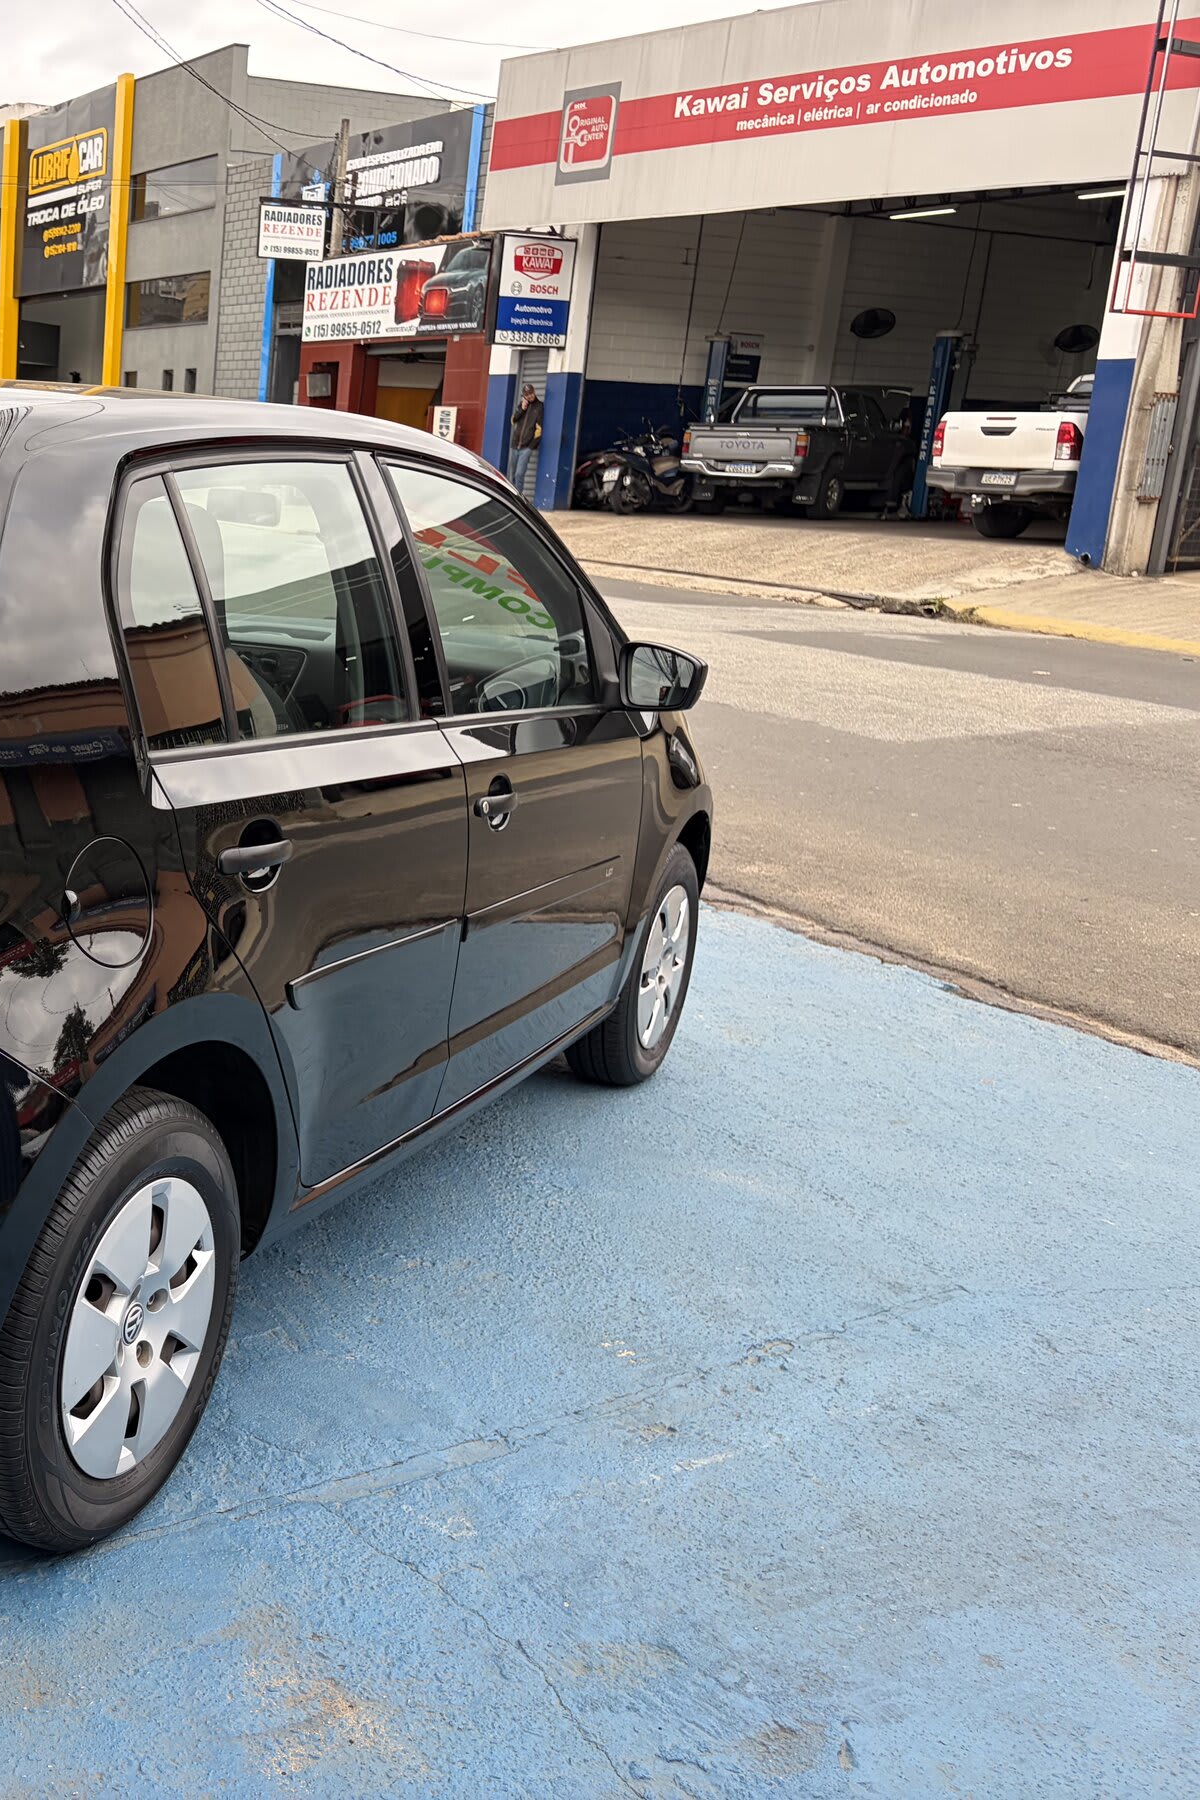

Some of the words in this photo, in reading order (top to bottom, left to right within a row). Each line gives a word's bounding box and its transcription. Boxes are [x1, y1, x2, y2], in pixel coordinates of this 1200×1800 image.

[674, 86, 749, 119] Kawai
[757, 71, 871, 102] Serviços
[880, 46, 1073, 91] Automotivos
[736, 110, 795, 132] mecânica
[803, 103, 853, 123] elétrica
[866, 103, 880, 115] ar
[883, 88, 978, 112] condicionado
[591, 123, 608, 132] AUTO
[356, 155, 440, 198] CONDICIONADO
[77, 180, 102, 195] SUPER
[27, 207, 59, 227] TROCA
[60, 201, 76, 219] DE
[77, 195, 105, 215] ÓLEO
[264, 210, 322, 226] RADIADORES
[263, 223, 322, 237] REZENDE
[522, 257, 553, 270] KAWAI
[307, 257, 394, 291] RADIADORES
[530, 284, 558, 295] BOSCH
[306, 285, 392, 312] REZENDE
[514, 303, 552, 315] Automotivo
[313, 325, 329, 338] (15)
[330, 320, 382, 337] 99855-0512
[510, 317, 528, 327] Injeção
[509, 331, 561, 346] 3388.6866
[439, 410, 451, 438] SERV
[919, 377, 937, 461] EMASTER
[720, 440, 765, 450] TOYOTA
